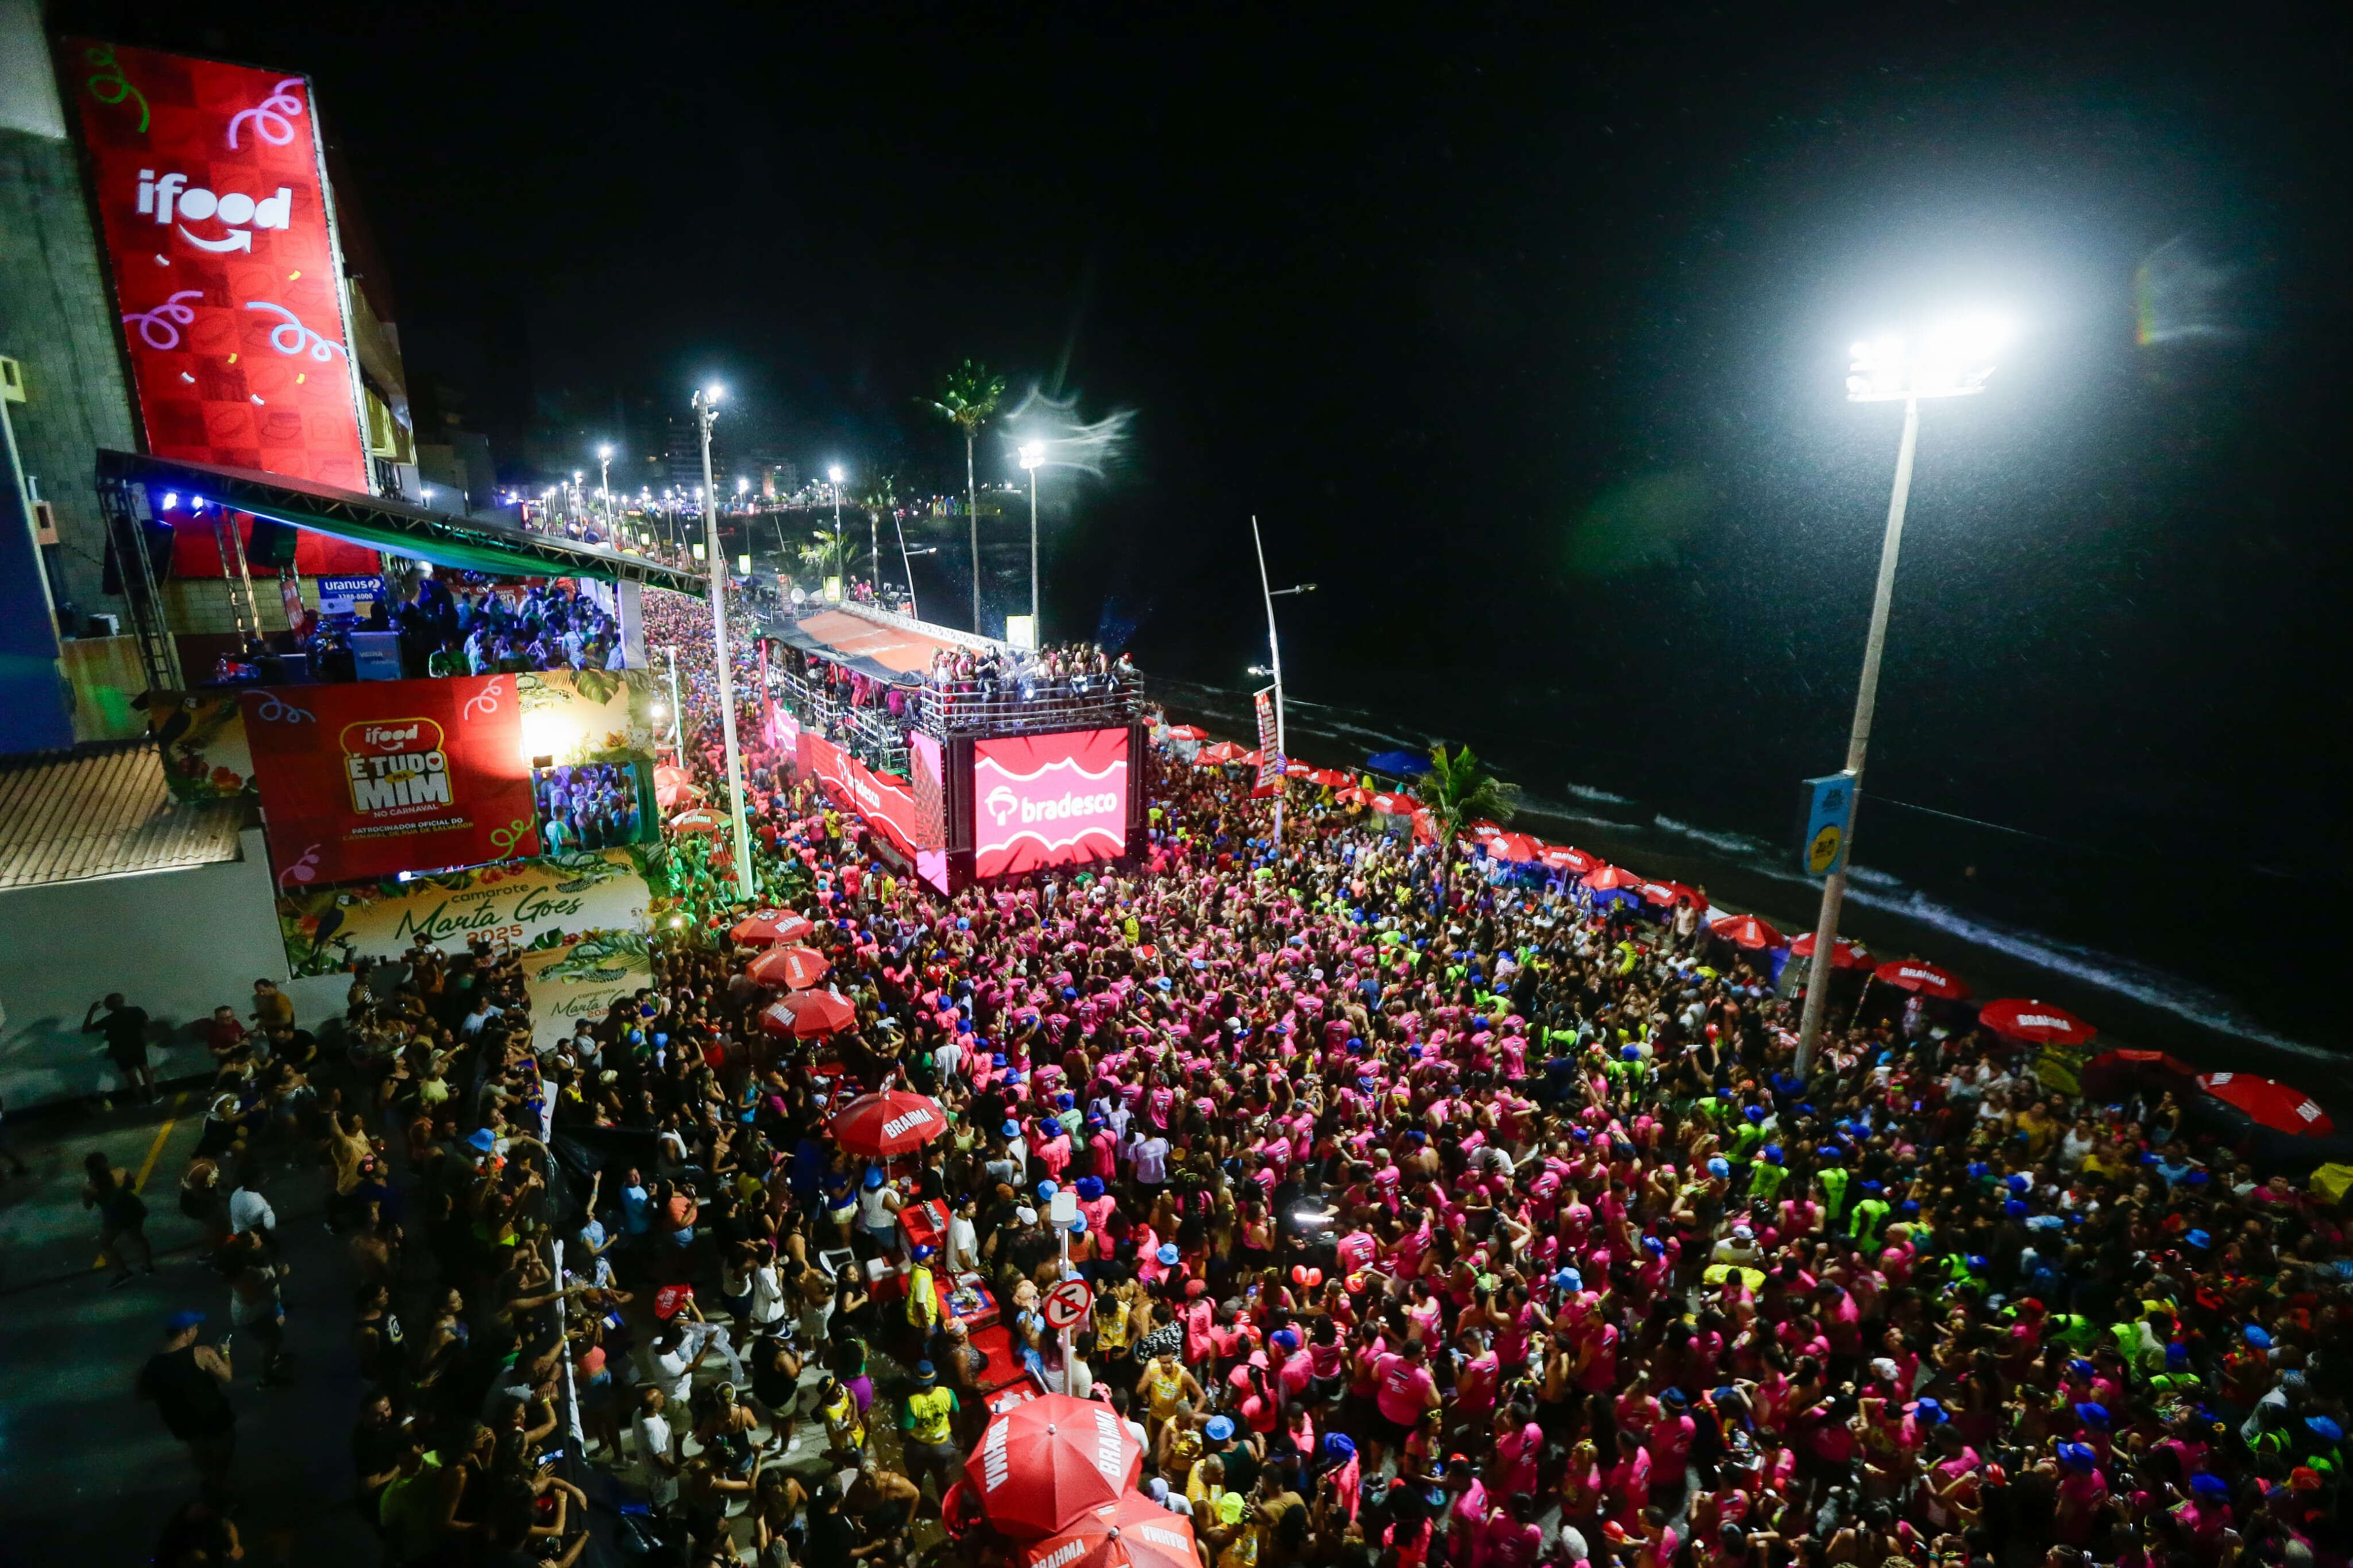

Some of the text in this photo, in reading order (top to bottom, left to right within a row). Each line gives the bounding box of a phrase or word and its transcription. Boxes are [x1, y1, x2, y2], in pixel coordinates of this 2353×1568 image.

[137, 169, 292, 230] ifood
[365, 724, 418, 745] ifood
[349, 751, 444, 778] É TUDO
[353, 771, 450, 811] MIM
[373, 804, 439, 818] NO CARNAVAL
[1021, 791, 1117, 823] bradesco
[352, 822, 416, 835] PATROCINADOR
[418, 818, 449, 828] OFICIAL
[682, 814, 711, 825] BRAHMA
[451, 883, 529, 903] camarote
[395, 898, 503, 941] Marta
[1899, 967, 1946, 987] BRAHMA
[551, 997, 603, 1017] Marta
[588, 1008, 610, 1018] 202
[883, 1108, 935, 1138] BRAHMA
[983, 1416, 1009, 1493] BRAHMA
[1093, 1408, 1123, 1477] BRAHMA
